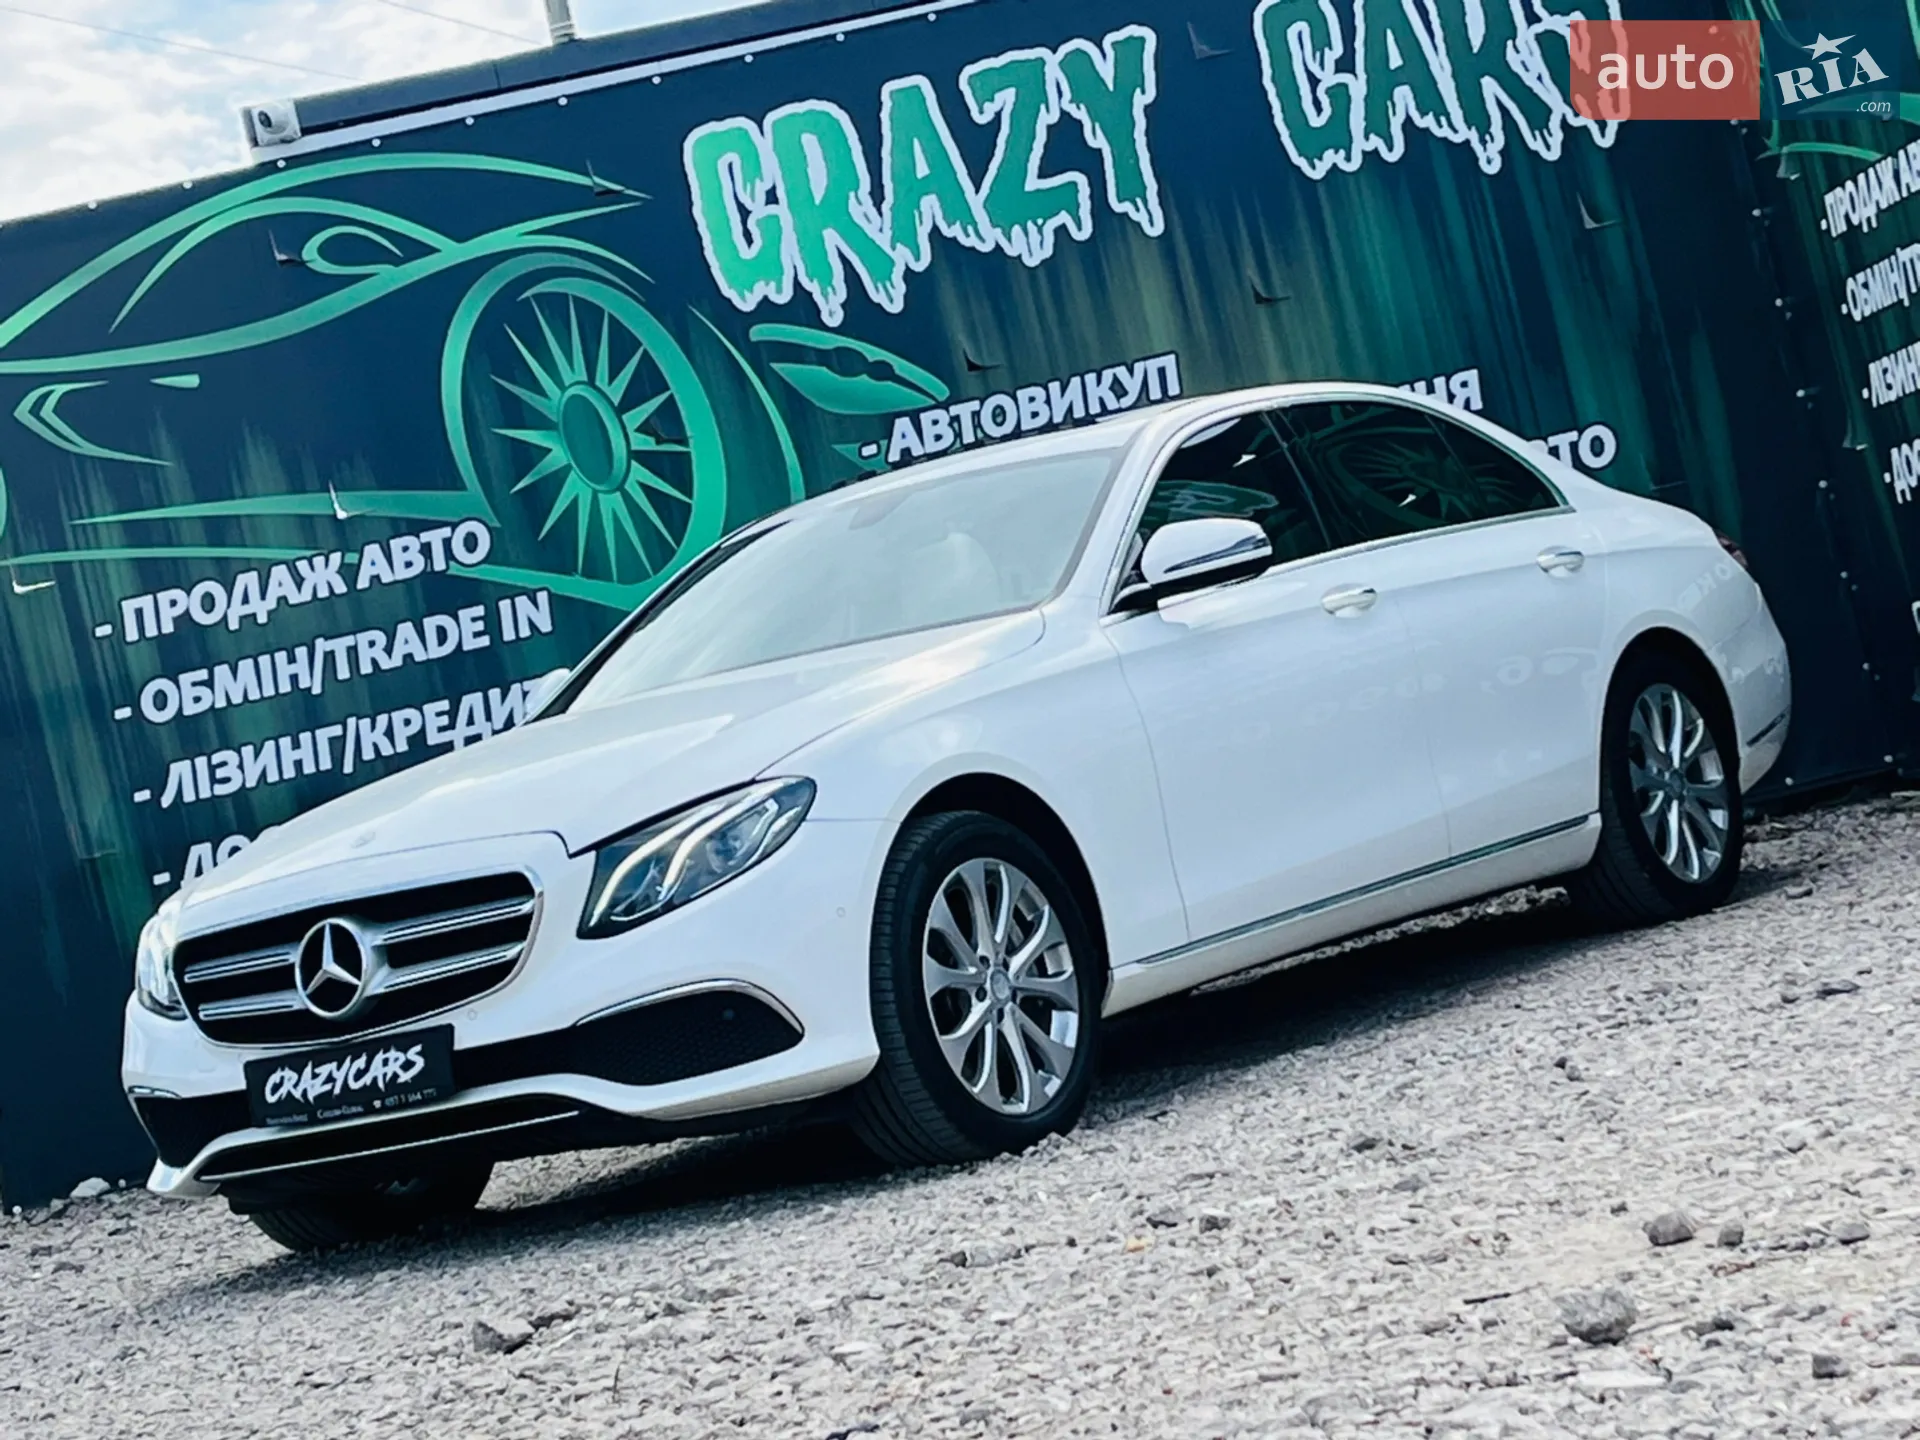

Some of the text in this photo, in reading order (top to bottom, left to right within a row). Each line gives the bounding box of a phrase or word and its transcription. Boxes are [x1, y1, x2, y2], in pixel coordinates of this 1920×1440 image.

[683, 25, 1165, 327] CRAZY
[1824, 155, 1900, 238] ПРОДАЖ
[886, 352, 1182, 464] АВТОВИКУП
[1868, 340, 1920, 409] ЛІЗИН
[1526, 423, 1618, 470] ТО
[121, 551, 348, 643] ПРОДАЖ
[356, 519, 491, 591] АВТО
[140, 604, 491, 724] ОБМІН/TRADE
[498, 591, 553, 643] IN
[265, 1043, 426, 1105] CRAZYCARS
